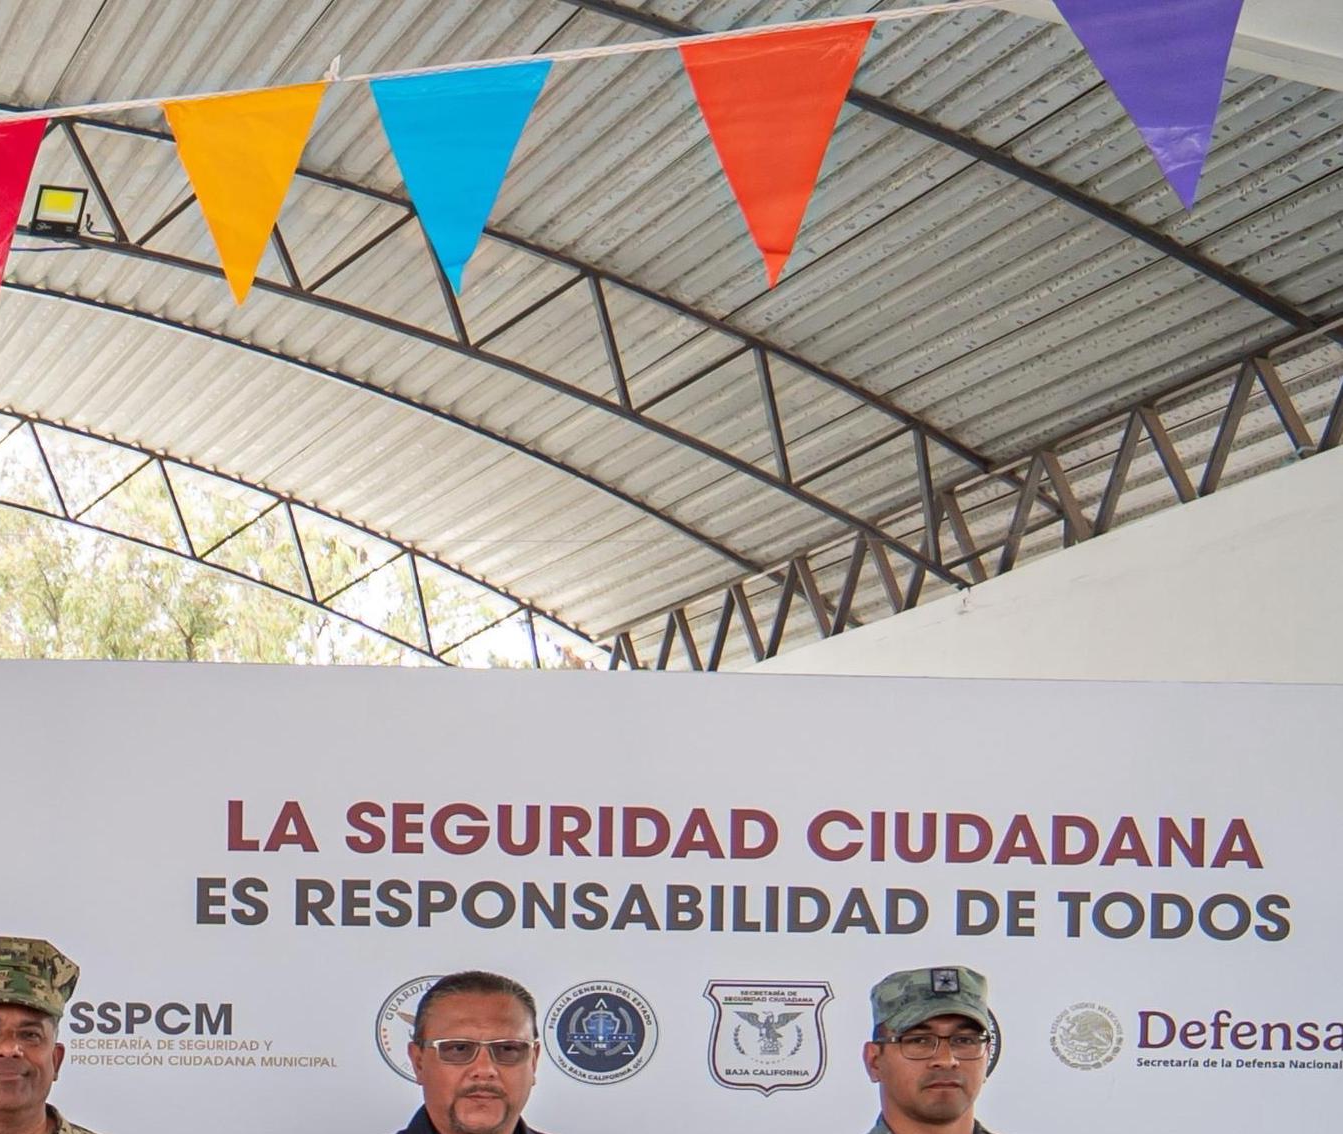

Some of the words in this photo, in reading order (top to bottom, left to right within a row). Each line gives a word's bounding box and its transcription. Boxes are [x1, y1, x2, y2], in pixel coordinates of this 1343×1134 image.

[227, 800, 319, 853] LA
[345, 801, 779, 860] SEGURIDAD
[806, 810, 1264, 869] CIUDADANA
[195, 877, 269, 926] ES
[295, 878, 929, 935] RESPONSABILIDAD
[956, 889, 1036, 937] DE
[1058, 891, 1291, 942] TODOS
[69, 1001, 233, 1036] SSPCM
[385, 982, 432, 1021] GUARDIA
[572, 985, 613, 998] GENERAL
[616, 987, 631, 998] DEL
[632, 997, 652, 1026] ESTADO
[70, 1036, 152, 1050] SECRETARÍA
[157, 1040, 174, 1050] DE
[179, 1040, 259, 1051] SEGURIDAD
[264, 1040, 273, 1051] Y
[1137, 1009, 1343, 1051] Defensa
[70, 1052, 163, 1066] PROTECCIÓN
[168, 1055, 256, 1067] CIUDADANA
[260, 1057, 337, 1068] MUNICIPAL
[569, 1066, 587, 1080] BAJA
[588, 1068, 632, 1081] CALIFORNIA
[725, 1068, 750, 1076] BAJA
[1136, 1057, 1199, 1068] Secretaría
[1202, 1058, 1218, 1068] de
[1221, 1058, 1232, 1068] la
[1235, 1058, 1286, 1069] Defensa
[1289, 1059, 1343, 1070] Nacional
